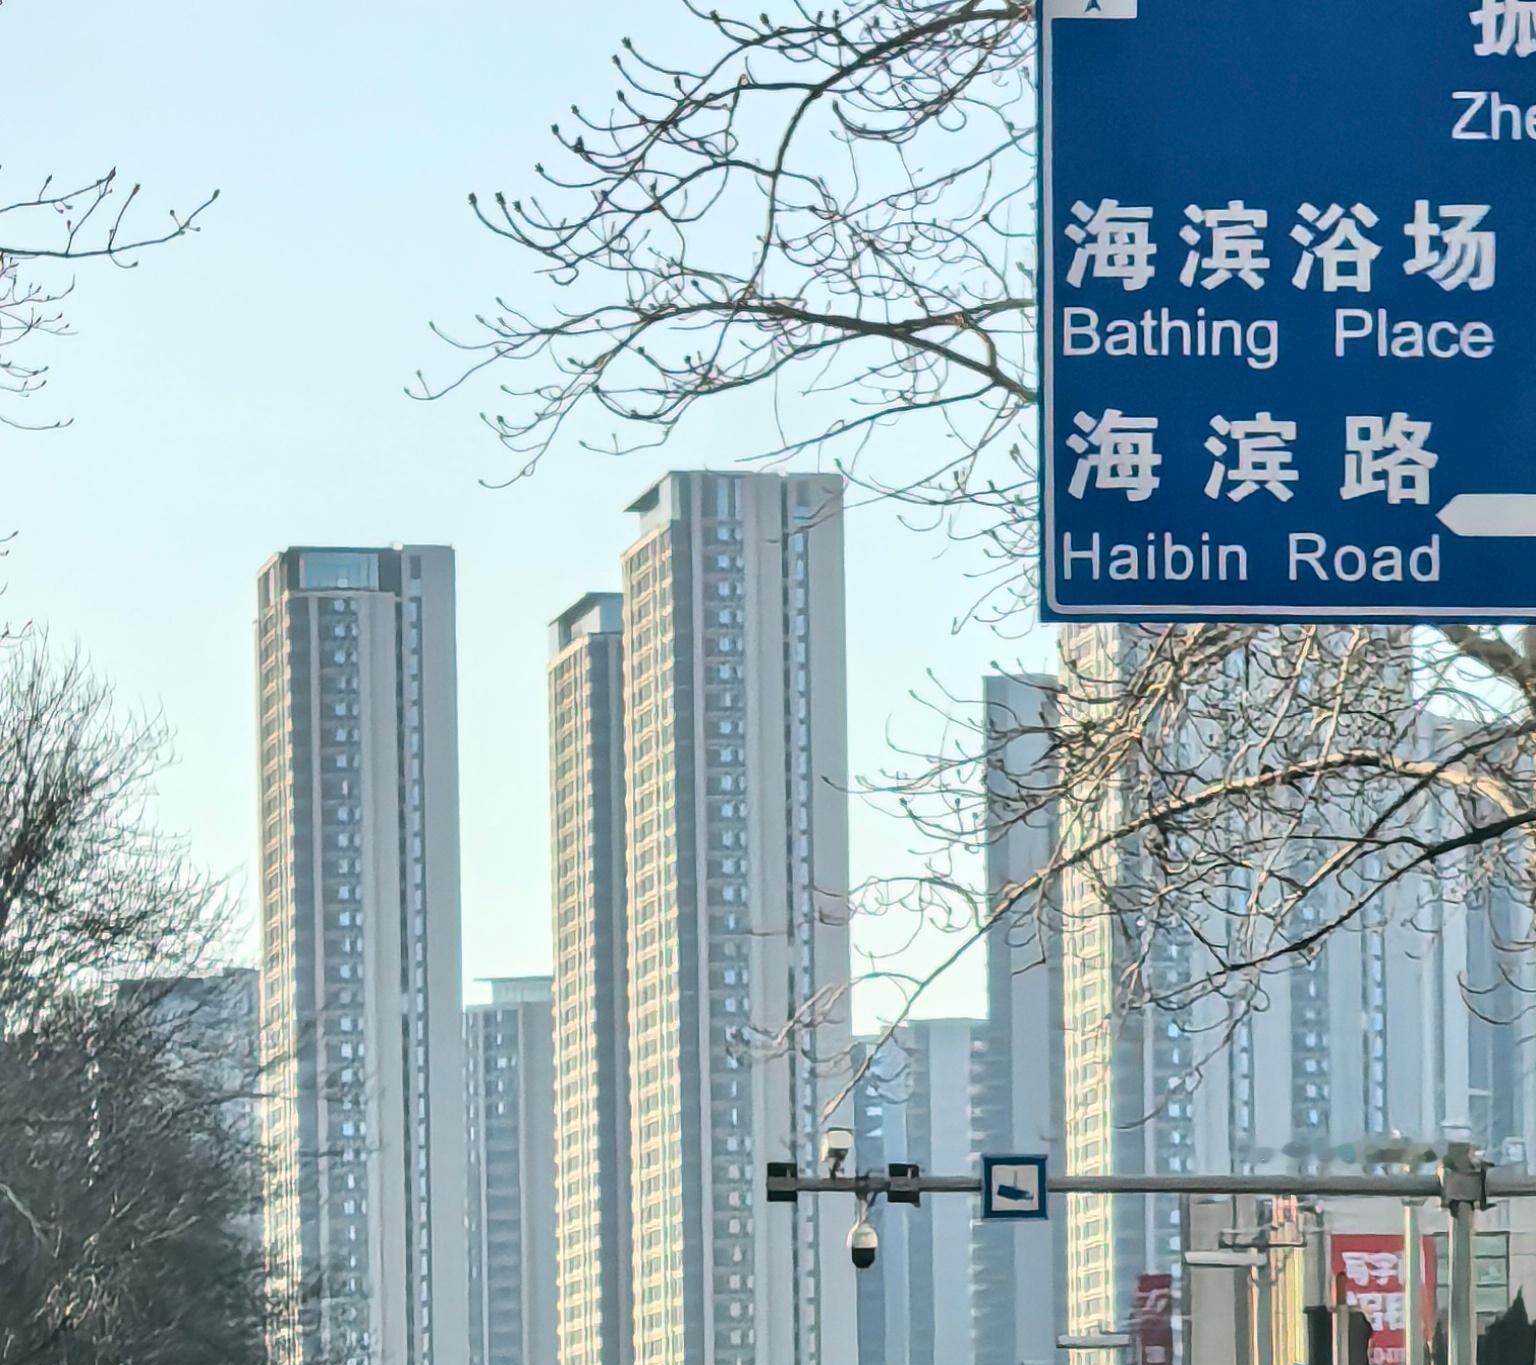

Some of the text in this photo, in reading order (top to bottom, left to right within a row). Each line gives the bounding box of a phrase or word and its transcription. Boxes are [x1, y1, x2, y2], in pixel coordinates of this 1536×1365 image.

[1064, 199, 1496, 292] 海滨浴场
[1063, 307, 1494, 369] Bathing Place
[1066, 409, 1439, 504] 海滨路
[1063, 532, 1440, 581] Haibin Road
